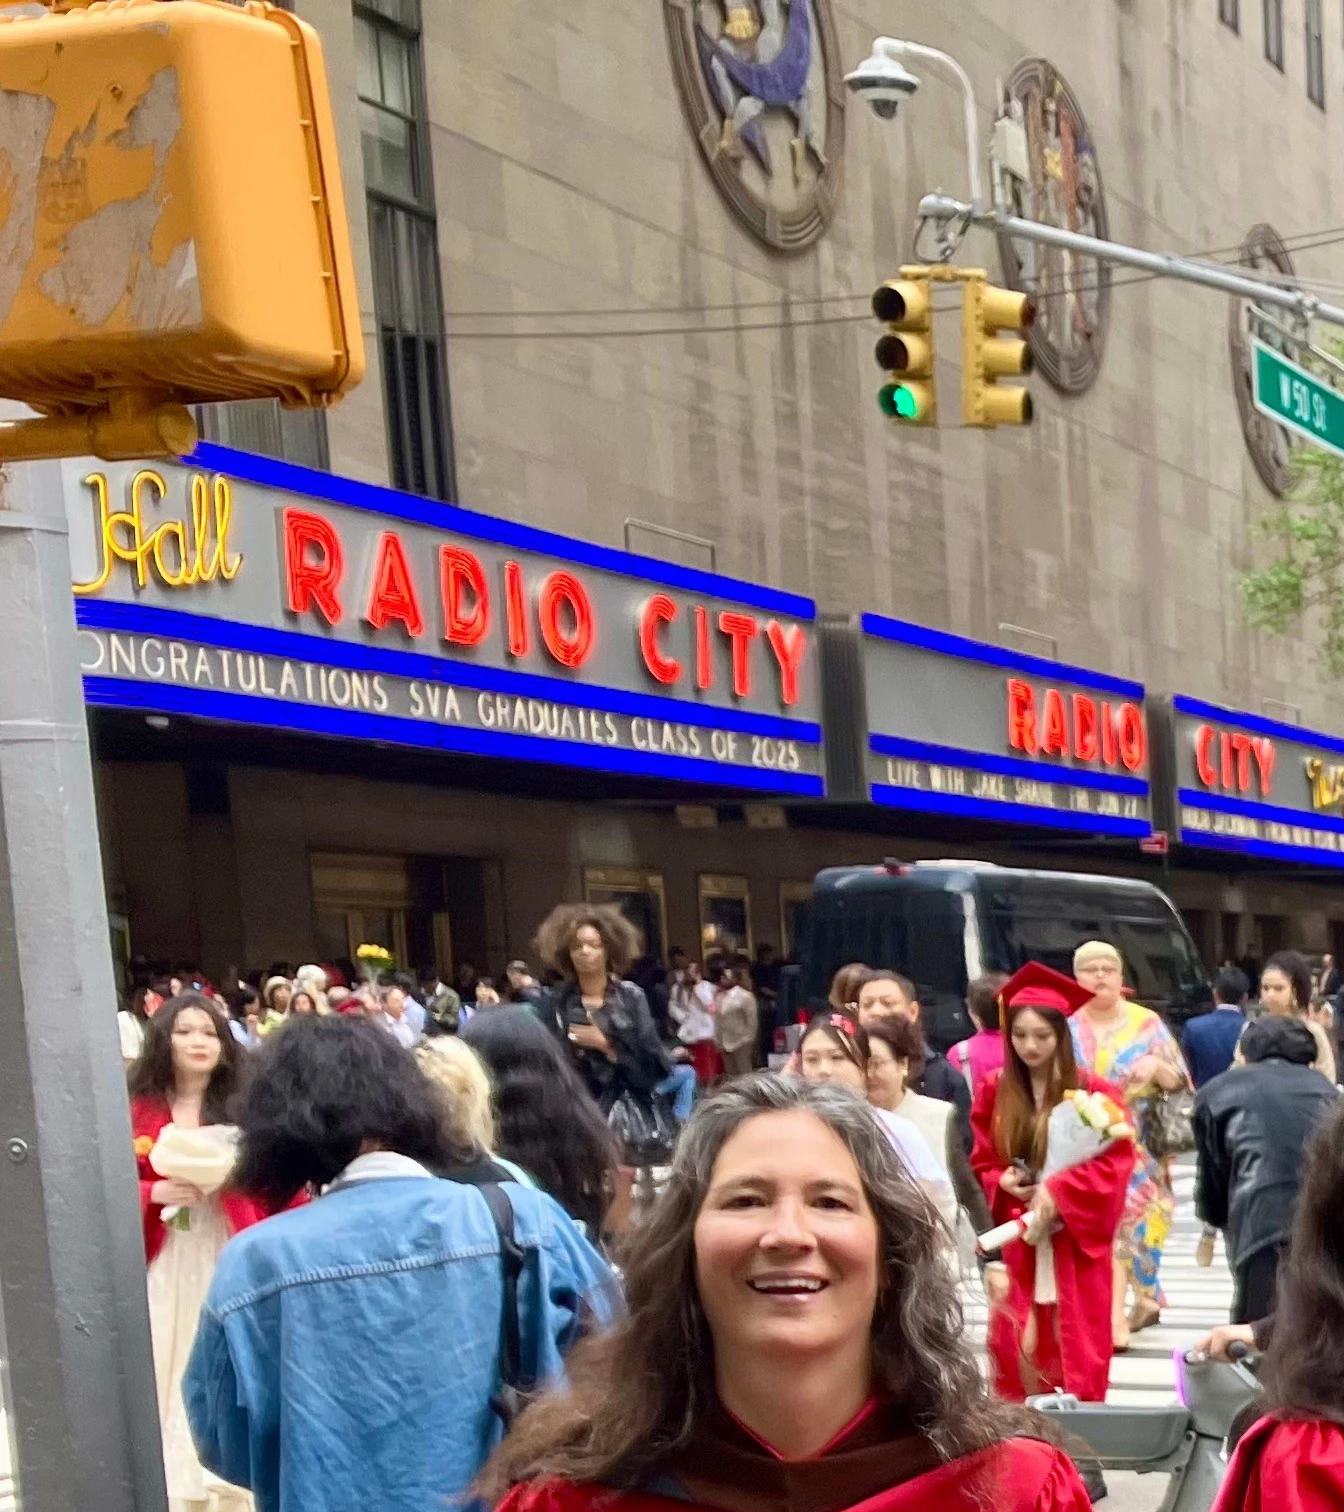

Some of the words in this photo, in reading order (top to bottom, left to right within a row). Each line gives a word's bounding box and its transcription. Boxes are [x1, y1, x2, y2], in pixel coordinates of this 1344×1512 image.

[282, 505, 594, 669] RADIO
[639, 592, 806, 706] CITY
[78, 629, 388, 713] ONGRATULATIONS
[409, 680, 462, 723] SVA
[477, 691, 619, 745] GRADUATES
[631, 717, 701, 757] CLASS
[711, 728, 737, 761] OF
[751, 736, 801, 770] 2025
[1007, 677, 1147, 773] RADIO
[887, 758, 921, 788] LIVE
[929, 763, 965, 794] WITH
[1194, 723, 1275, 796] CITY
